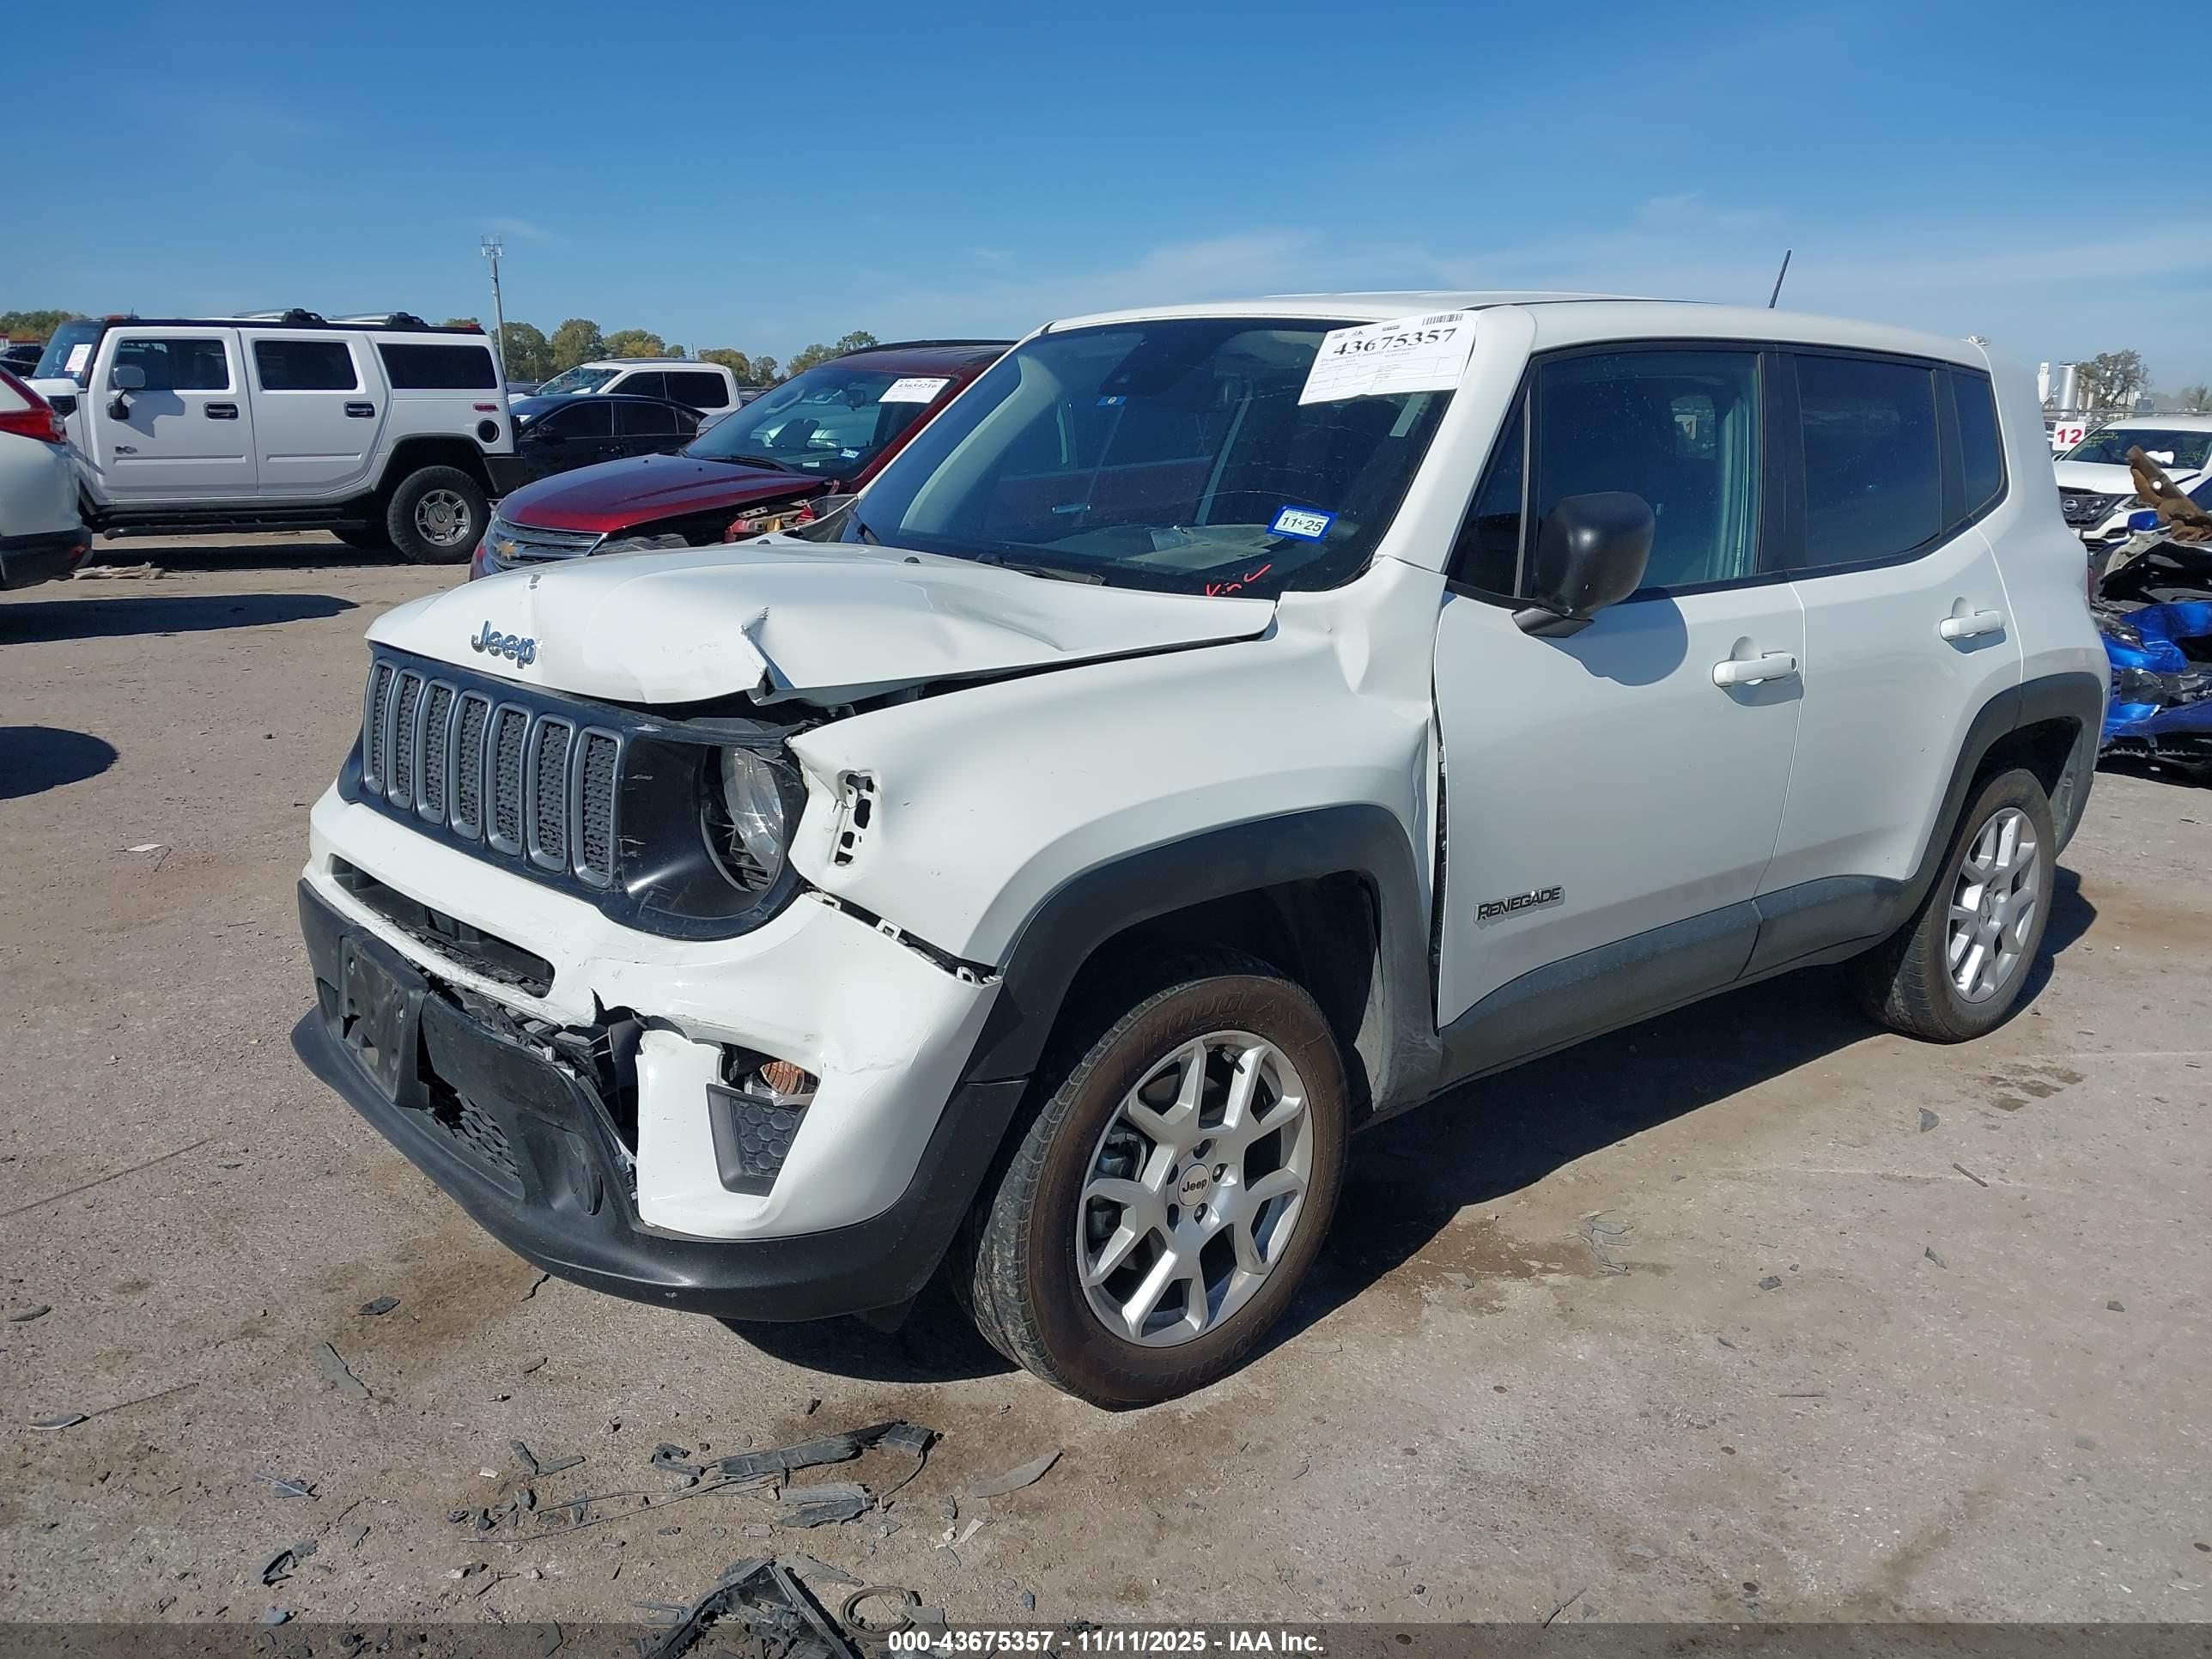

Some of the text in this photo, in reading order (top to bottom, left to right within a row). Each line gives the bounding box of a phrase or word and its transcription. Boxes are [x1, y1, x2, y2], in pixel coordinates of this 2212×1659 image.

[1333, 327, 1458, 356] 43675357
[2057, 428, 2083, 444] 12
[1282, 516, 1324, 532] 11 25
[471, 620, 538, 670] Jeep
[1476, 886, 1562, 921] RENEGADE
[1182, 1178, 1207, 1192] Jeep
